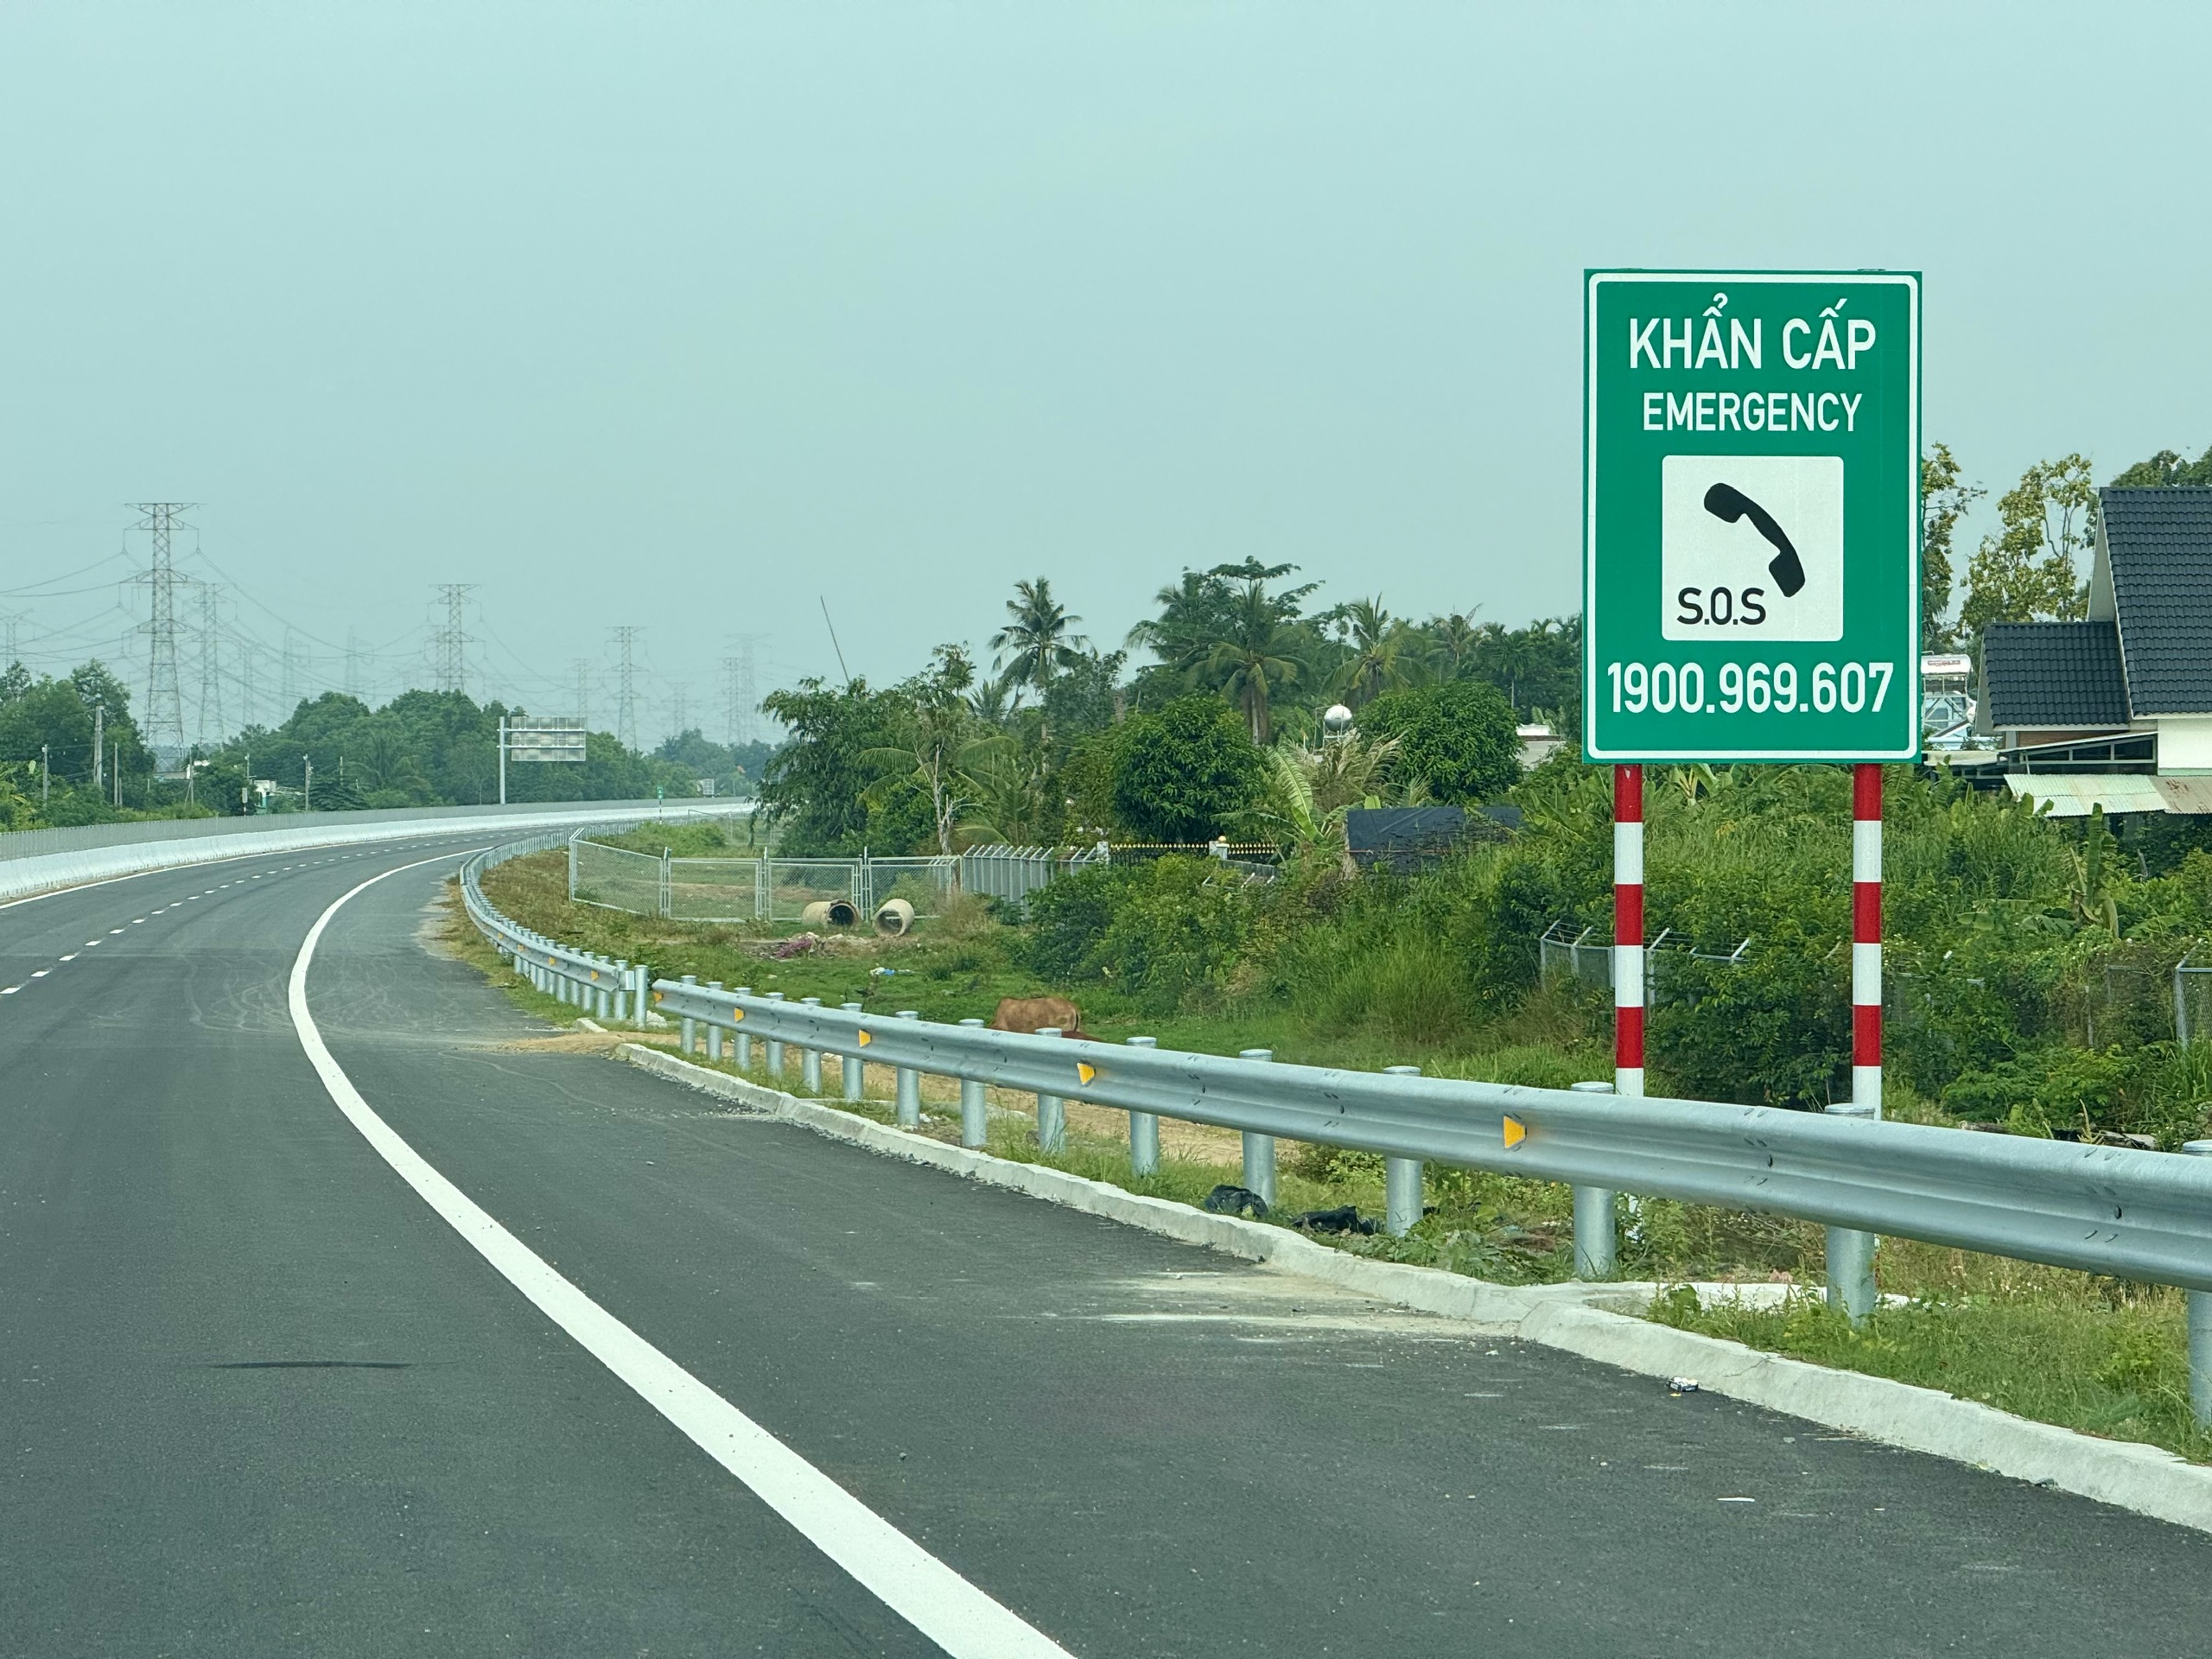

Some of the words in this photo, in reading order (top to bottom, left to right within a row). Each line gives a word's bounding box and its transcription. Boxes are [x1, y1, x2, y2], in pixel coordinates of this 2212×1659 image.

[1630, 292, 1762, 369] KHẨN
[1783, 298, 1876, 370] CẤP
[1643, 391, 1863, 432] EMERGENCY
[1676, 586, 1766, 626] S.O.S
[1607, 662, 1894, 714] 1900.969.607
